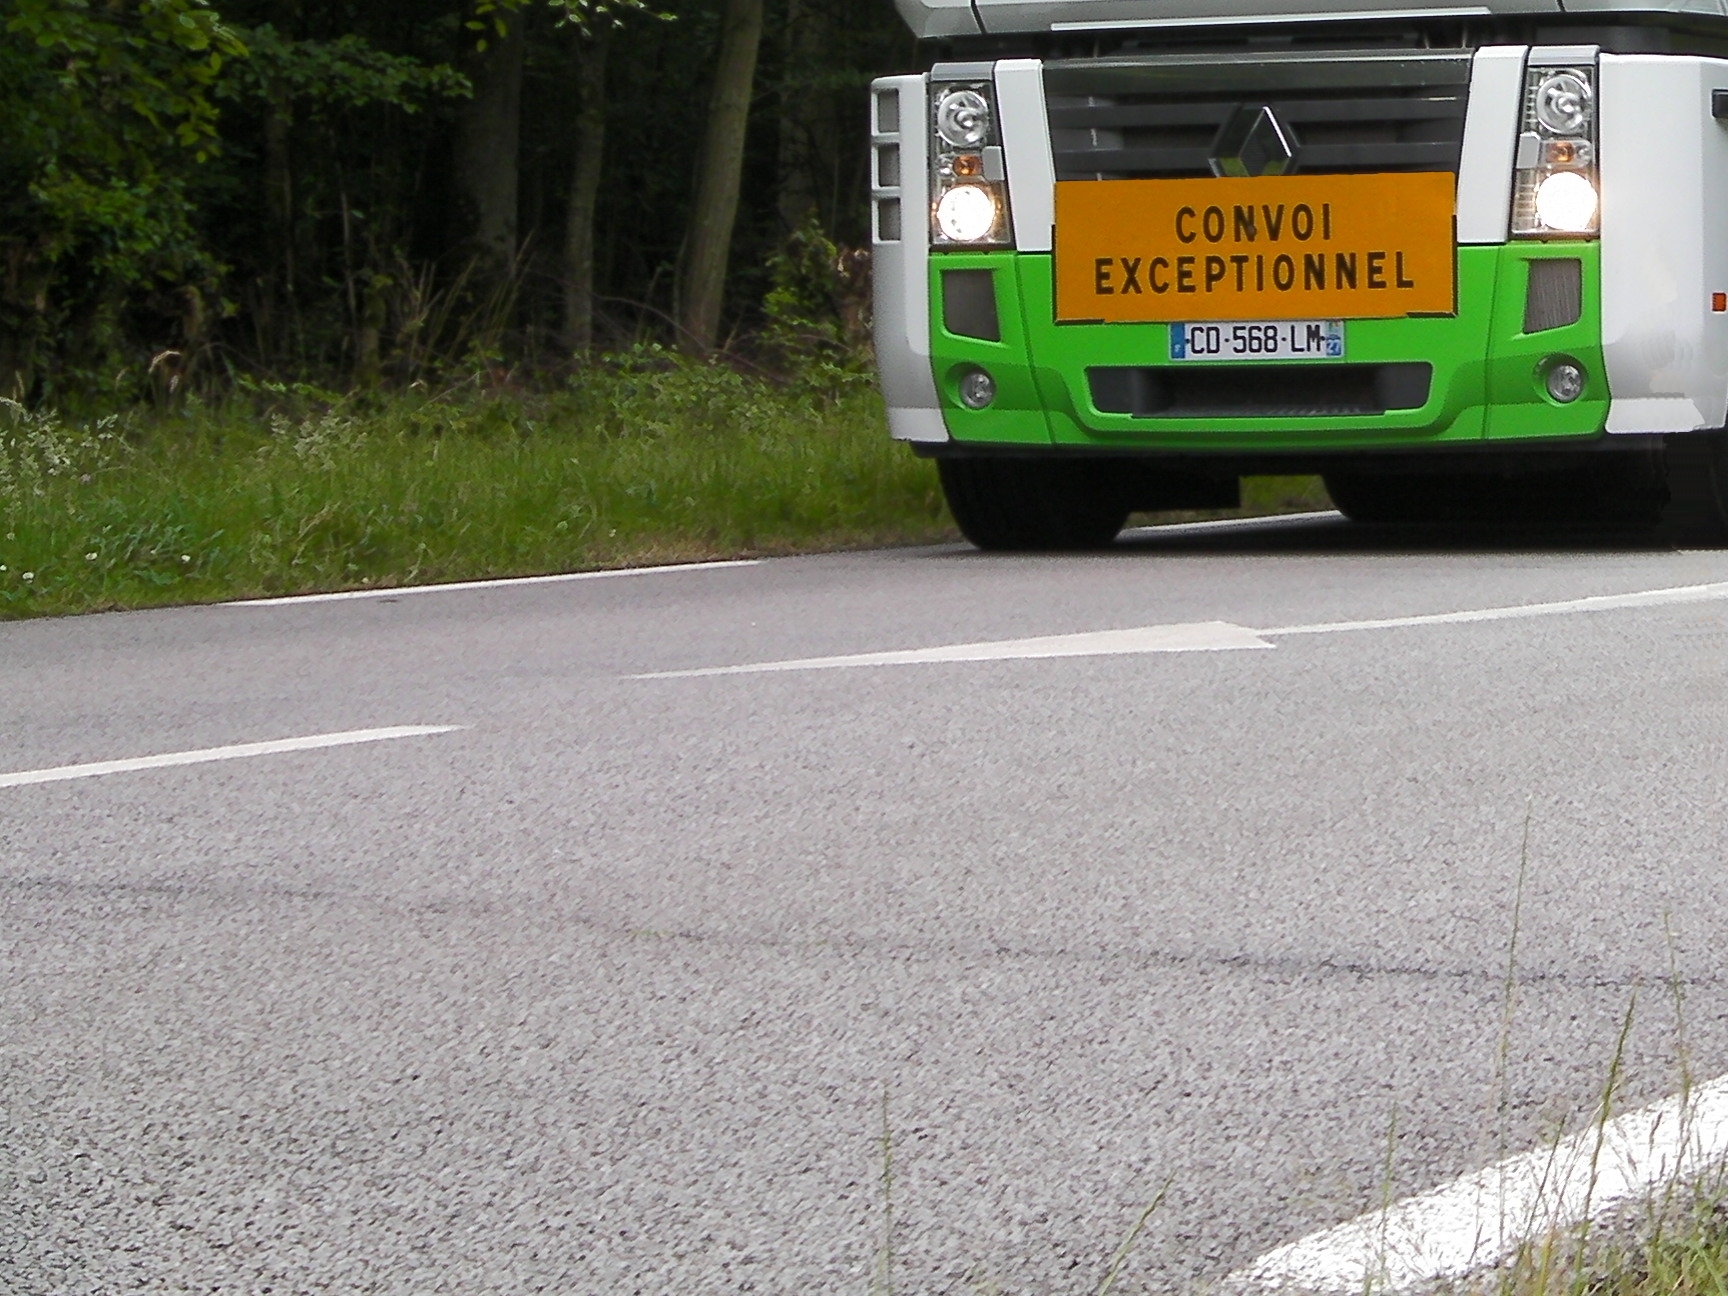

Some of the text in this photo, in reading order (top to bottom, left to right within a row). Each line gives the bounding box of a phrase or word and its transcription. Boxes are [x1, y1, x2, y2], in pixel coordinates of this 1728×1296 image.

[1175, 203, 1331, 244] CONVOI
[1094, 251, 1415, 294] EXCEPTIONNEL
[1326, 339, 1340, 354] 27
